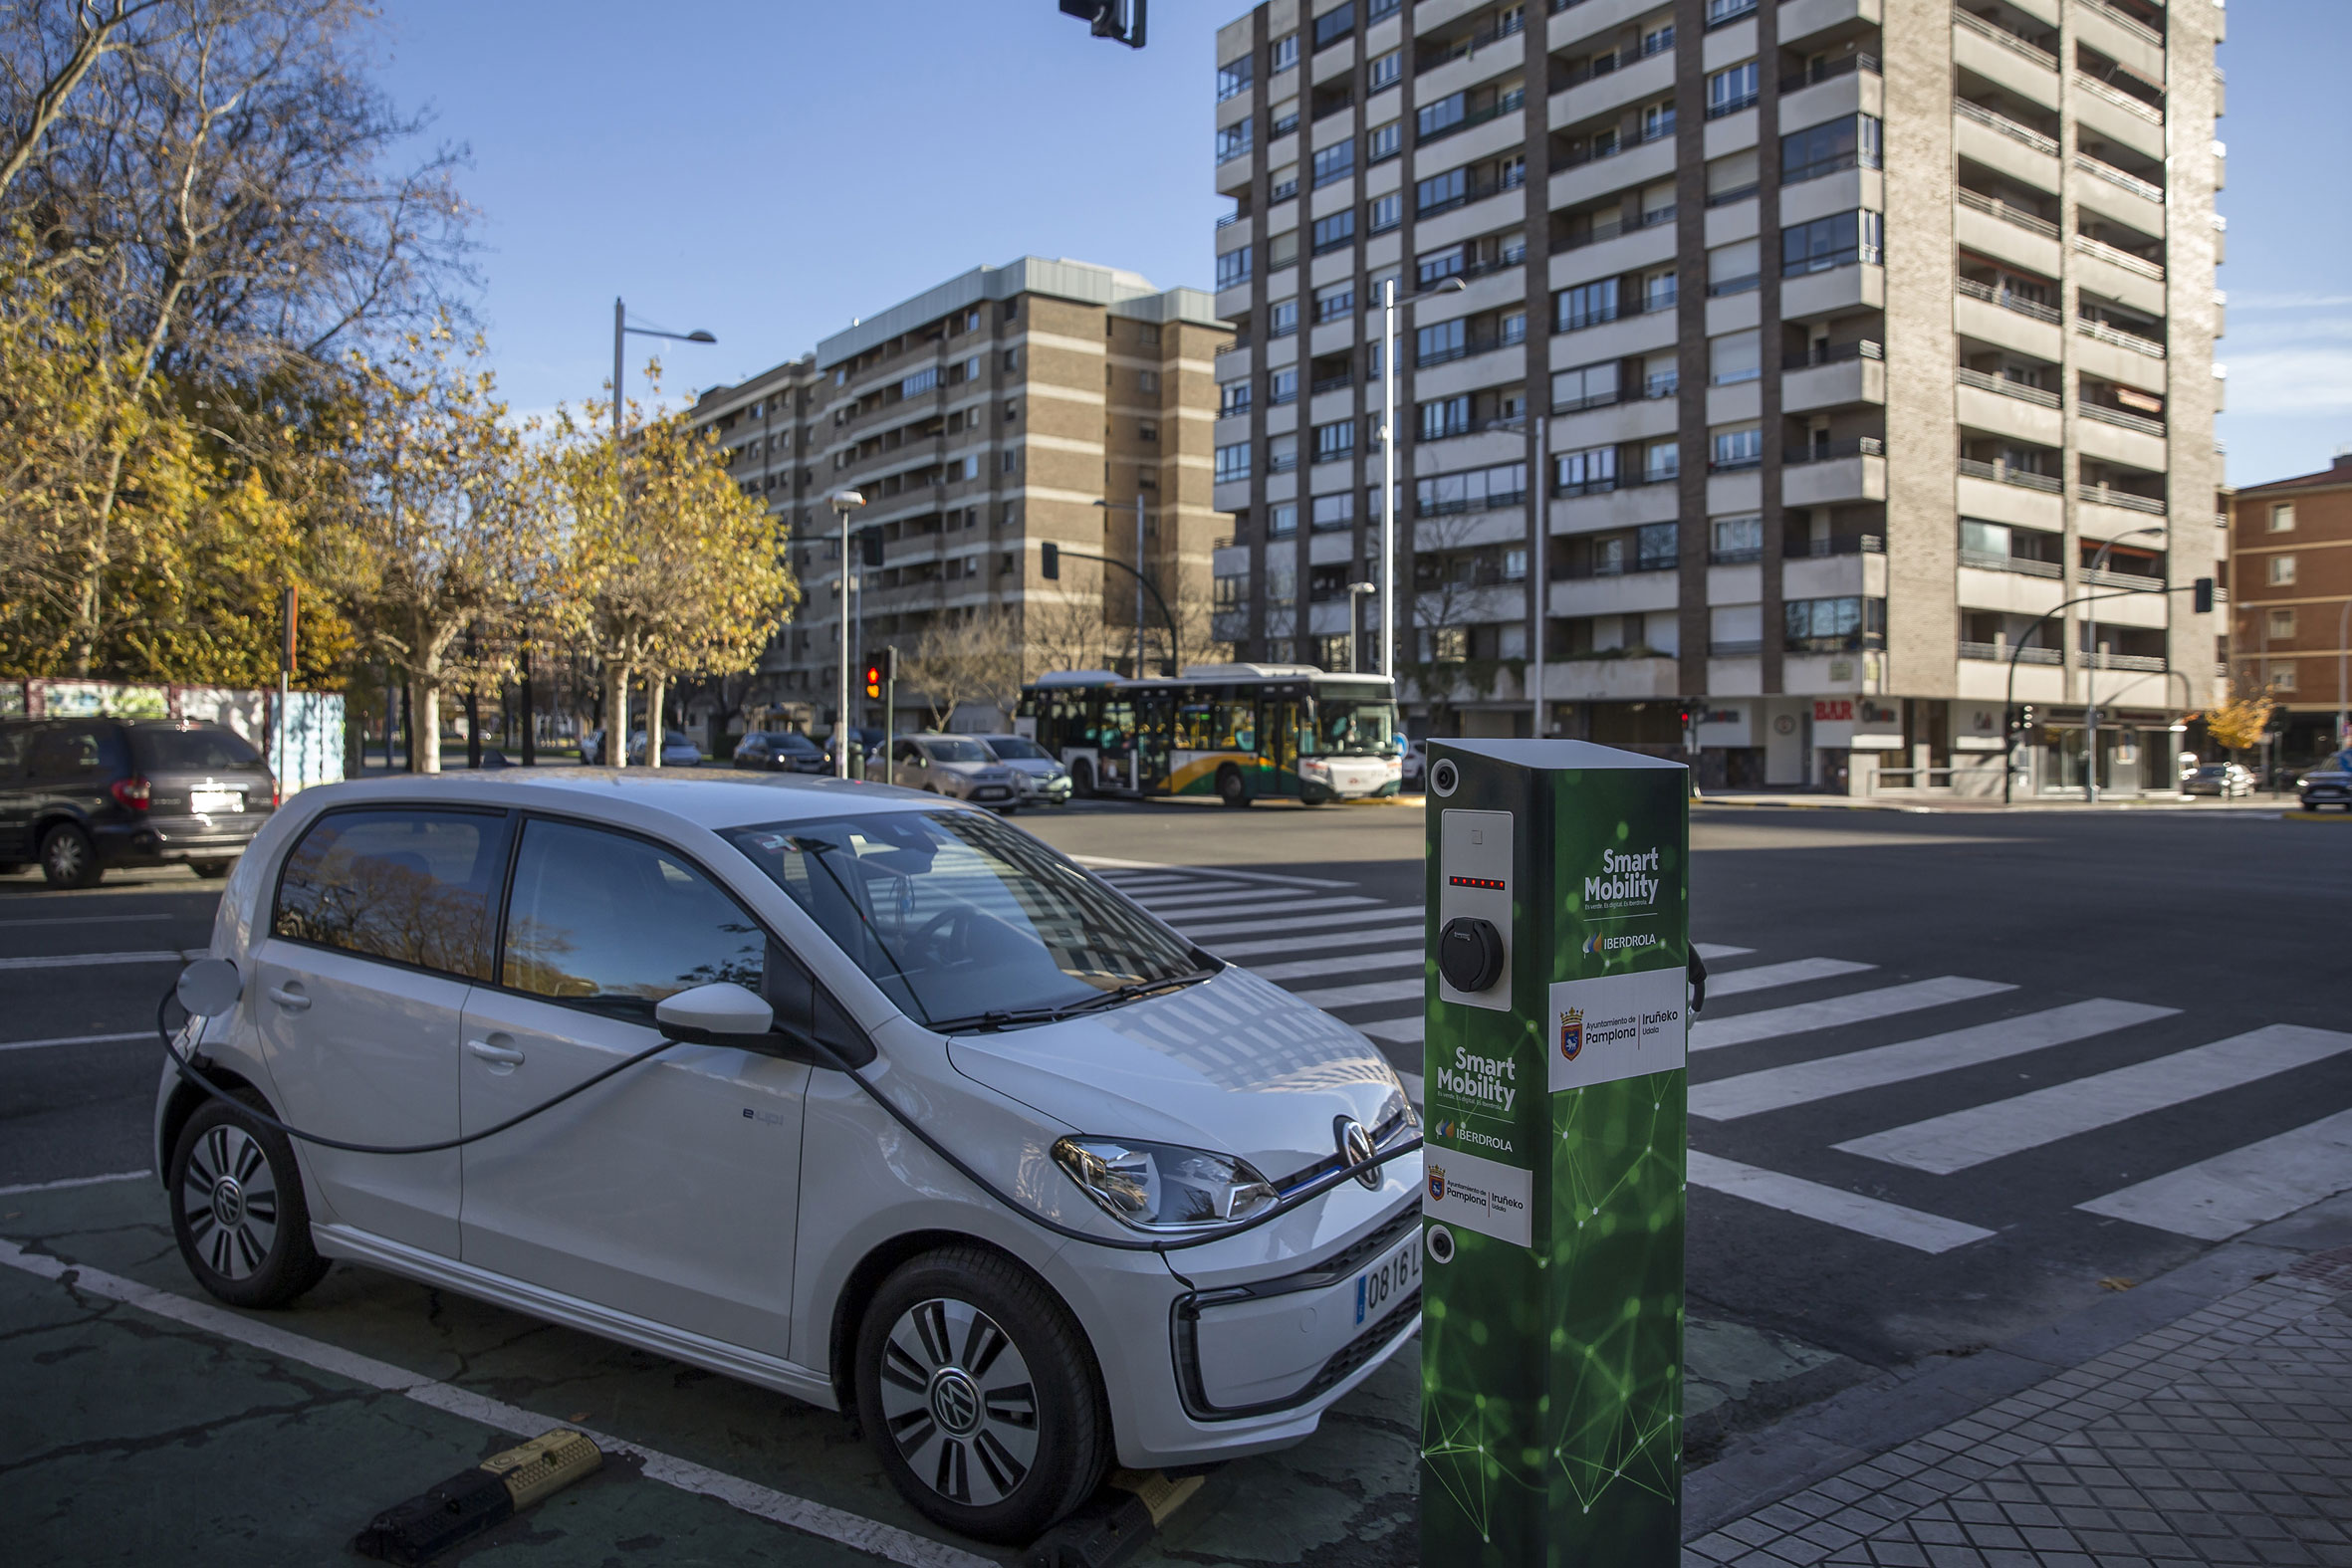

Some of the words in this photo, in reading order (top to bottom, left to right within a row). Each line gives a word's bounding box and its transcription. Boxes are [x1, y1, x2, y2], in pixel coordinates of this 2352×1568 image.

[1814, 701, 1853, 720] BAR
[1602, 846, 1659, 874] Smart
[1584, 872, 1659, 904] Mobility
[1604, 934, 1656, 950] IBERDROLA
[1586, 1017, 1627, 1031] Ayuntamiento
[1642, 1009, 1678, 1024] Iruñeko
[1585, 1027, 1636, 1044] Pamplona
[1642, 1026, 1659, 1035] Udala
[1455, 1046, 1516, 1080] Smart
[1437, 1066, 1516, 1111] Mobility
[1456, 1128, 1513, 1153] IBERDROLA
[1447, 1180, 1479, 1194] Ayuntamiento
[1447, 1188, 1486, 1207] Pamplona
[1492, 1193, 1524, 1210] Iruñeko
[1492, 1204, 1507, 1213] Udala
[1368, 1250, 1409, 1309] 0816
